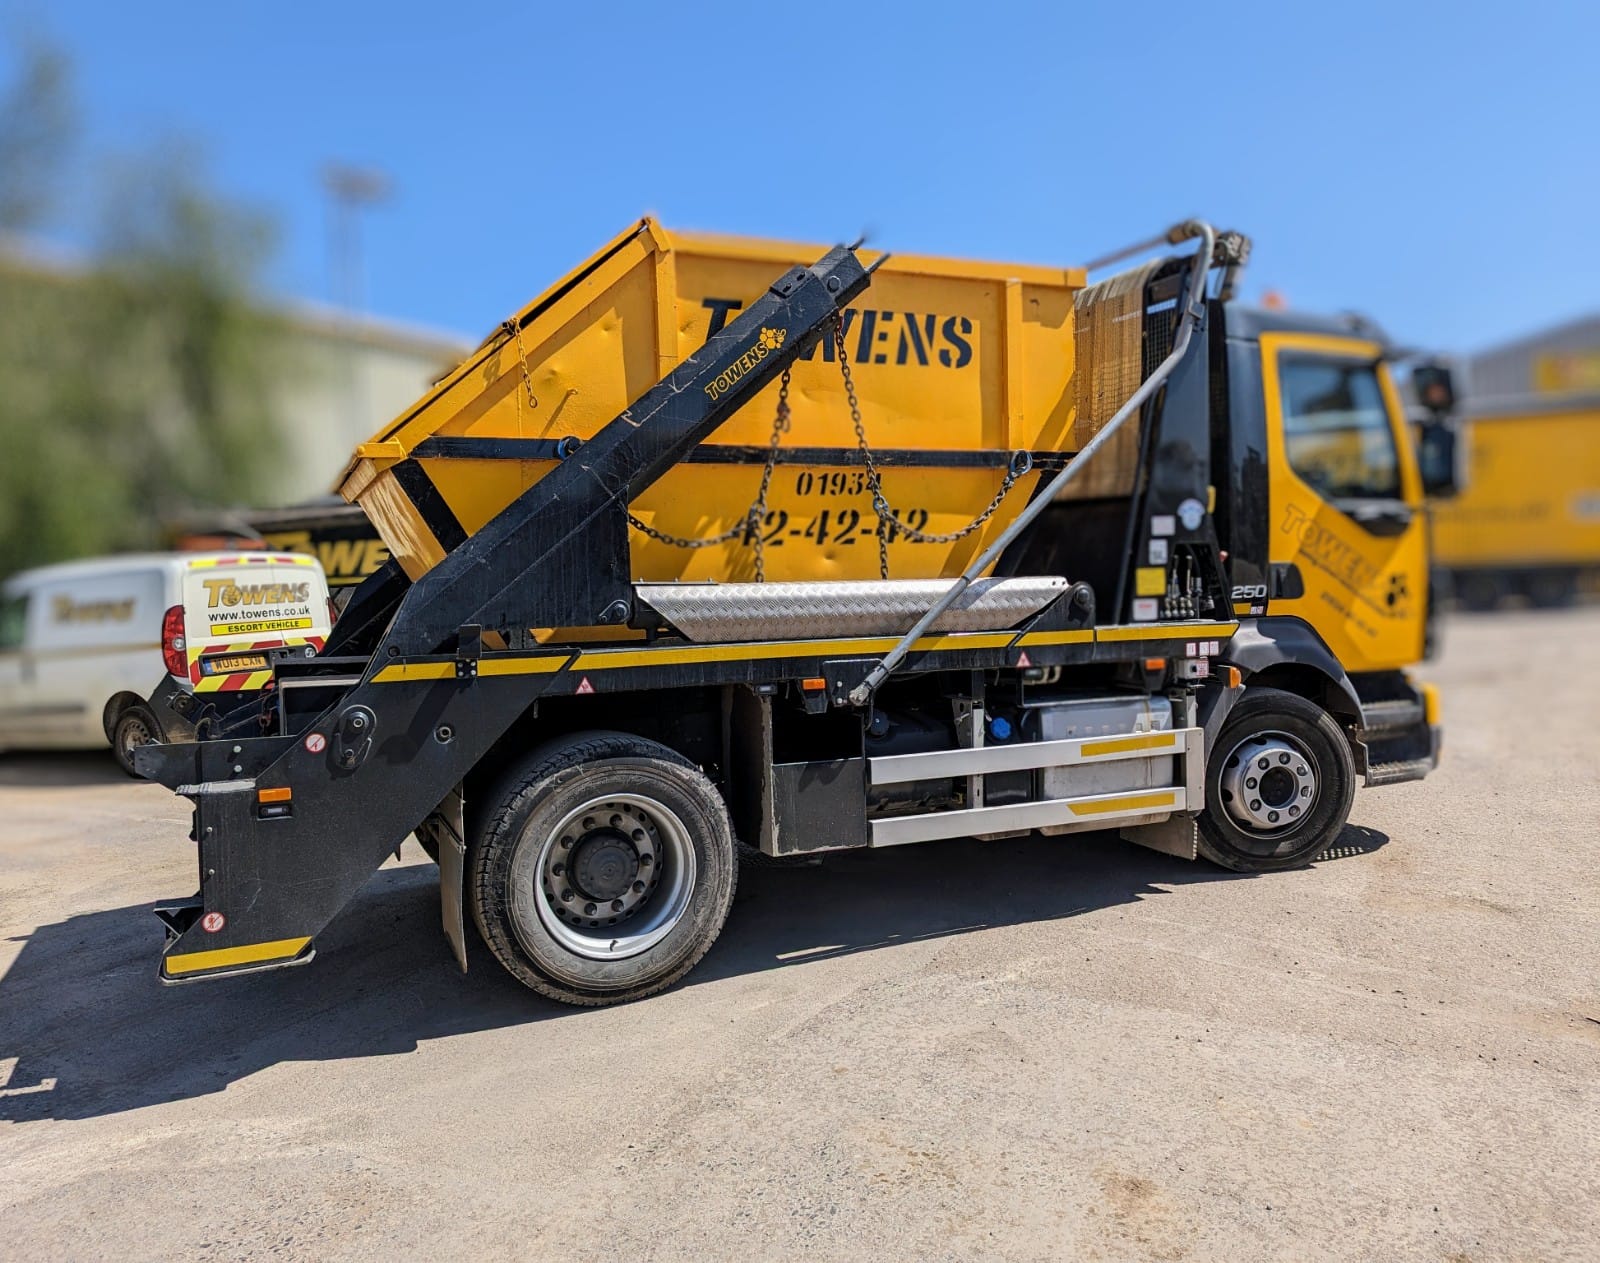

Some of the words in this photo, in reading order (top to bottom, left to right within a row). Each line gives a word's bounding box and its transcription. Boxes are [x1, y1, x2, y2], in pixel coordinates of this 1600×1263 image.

[705, 341, 769, 400] TOWENS
[203, 578, 310, 608] TOWENS
[1231, 585, 1268, 599] 250
[208, 606, 311, 621] www.towens.co.uk
[228, 623, 263, 633] ESCORT
[266, 620, 300, 630] VEHICLE
